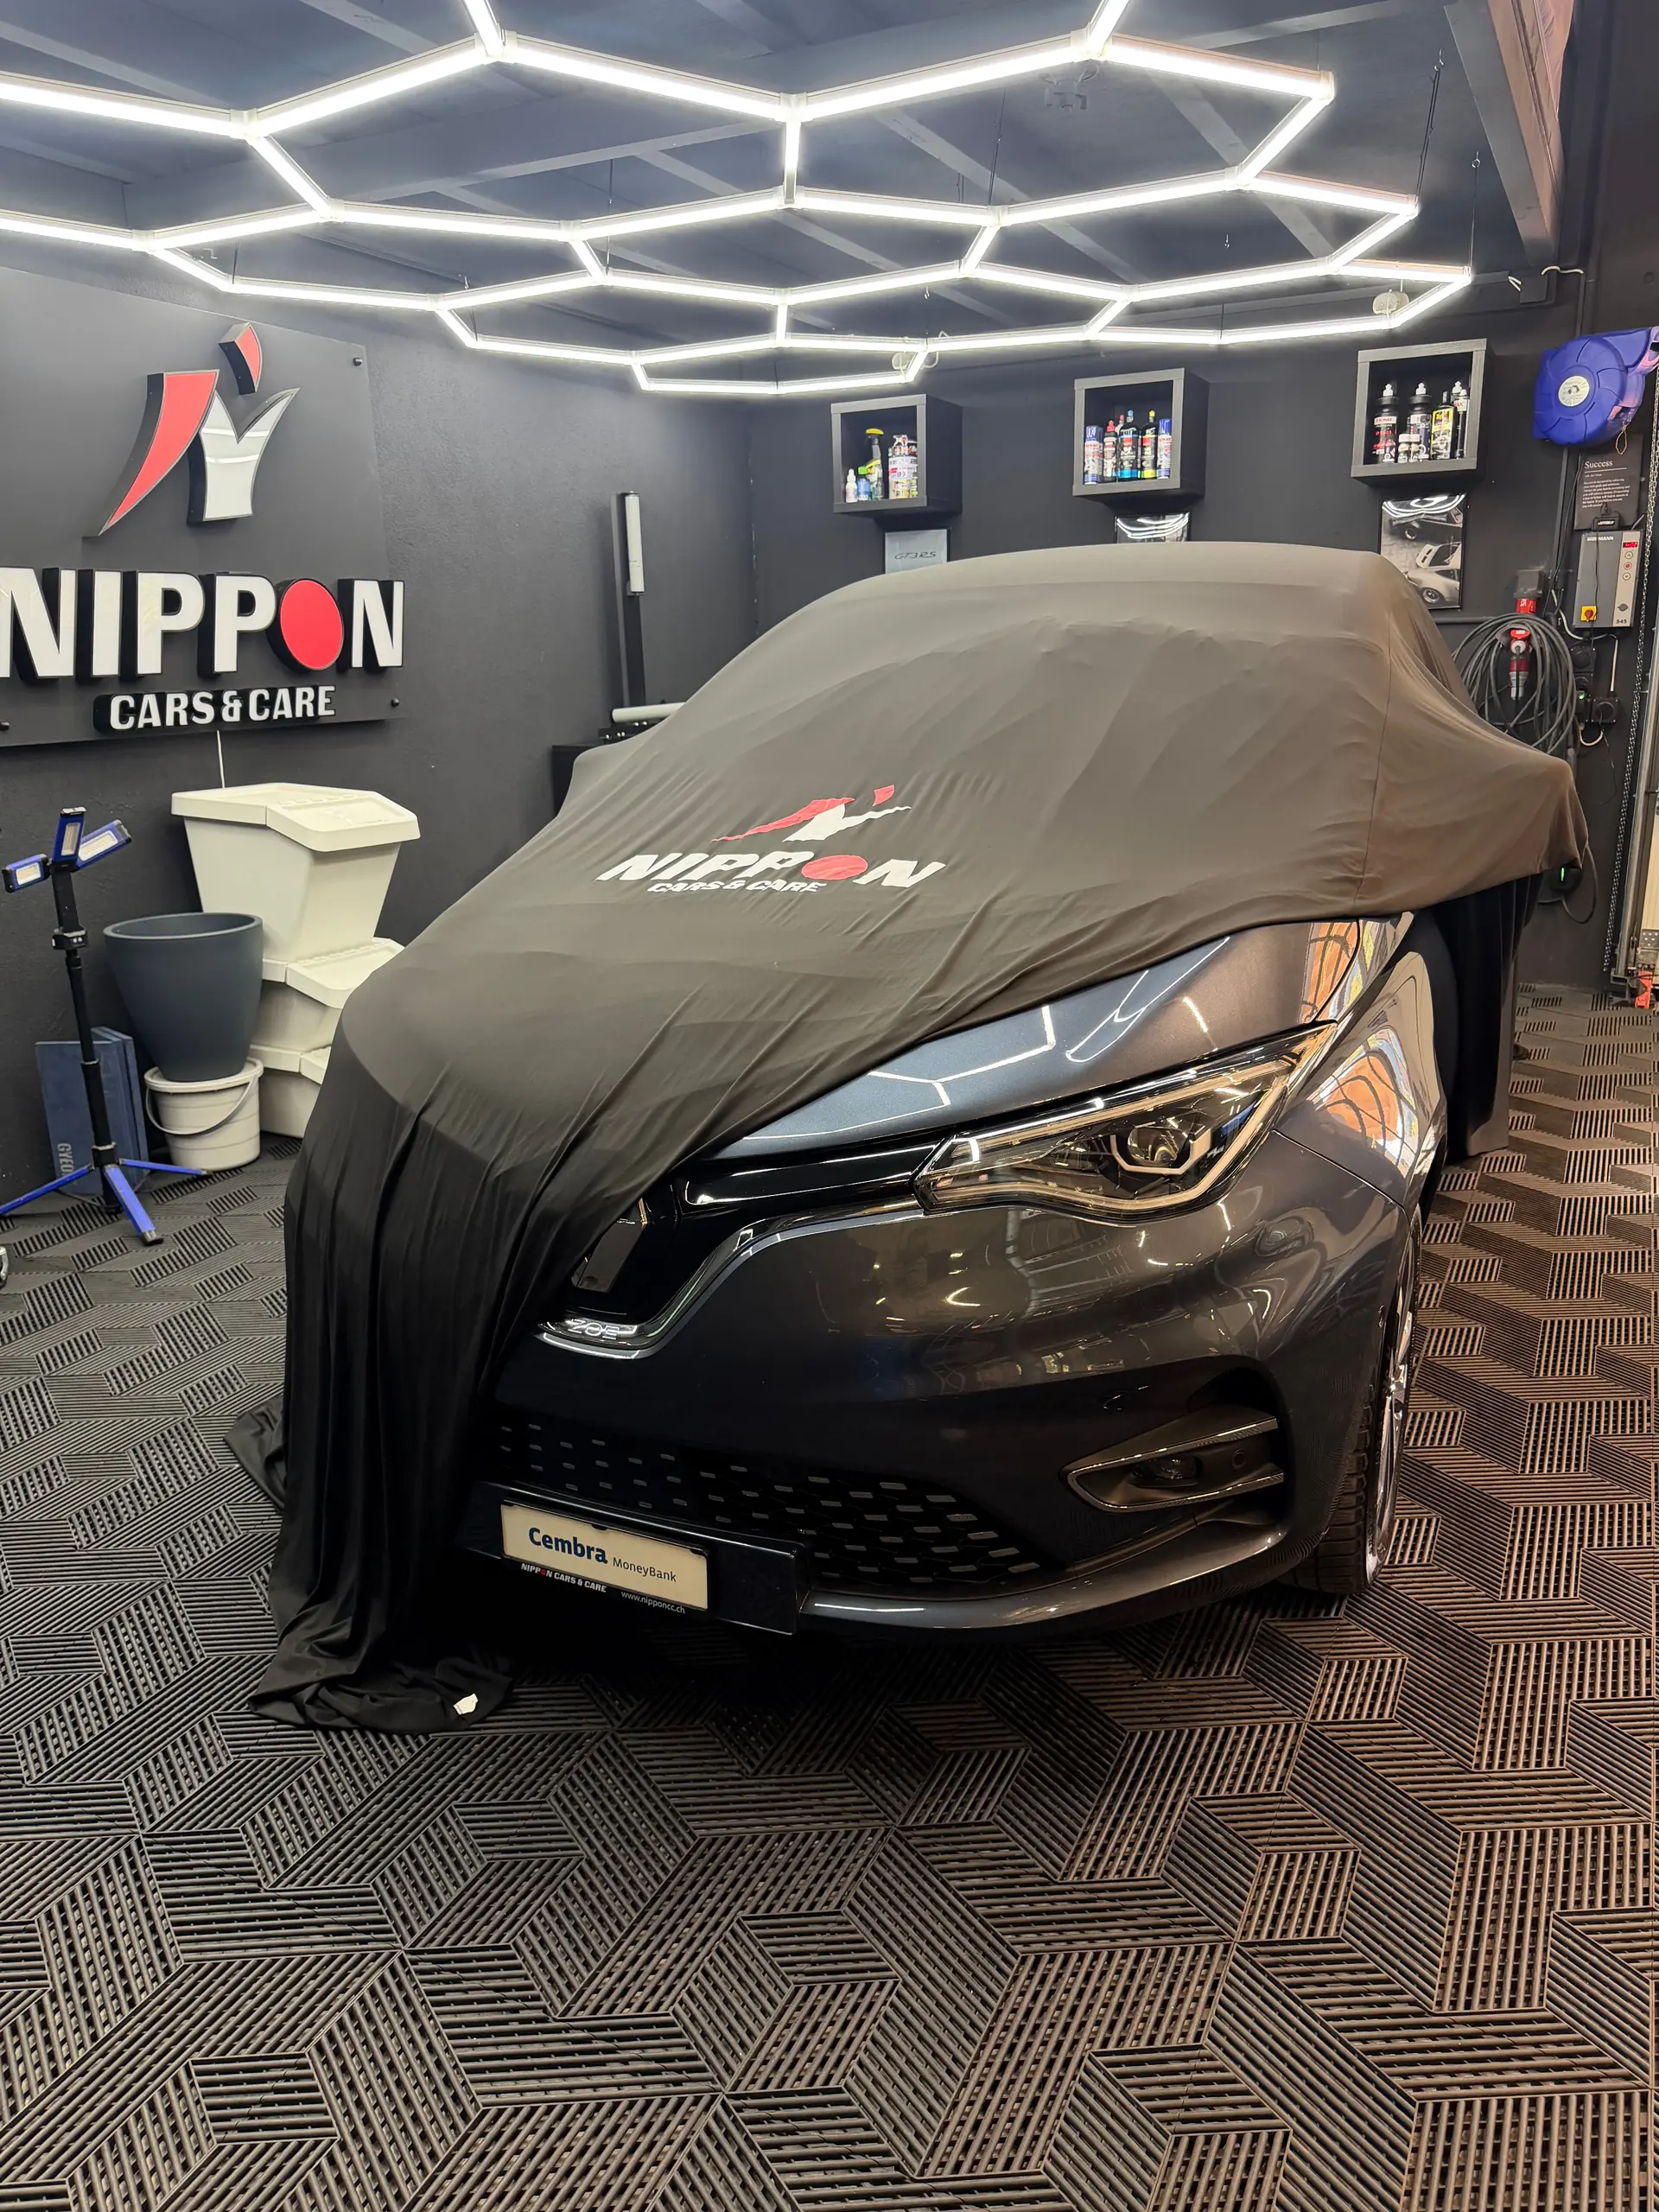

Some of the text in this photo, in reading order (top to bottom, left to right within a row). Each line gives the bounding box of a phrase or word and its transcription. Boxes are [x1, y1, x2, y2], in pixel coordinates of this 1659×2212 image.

[0, 567, 405, 679] NIPPON
[595, 851, 946, 888] NIPPON
[57, 1143, 73, 1176] GYEO
[567, 1319, 620, 1339] ZOE
[528, 1527, 608, 1564] Cembra
[520, 1562, 553, 1579] NIPPON
[553, 1572, 576, 1585] CARS
[584, 1580, 607, 1593] CARE
[613, 1557, 677, 1582] MoneyBank
[620, 1590, 685, 1614] www.nipponcc.ch
